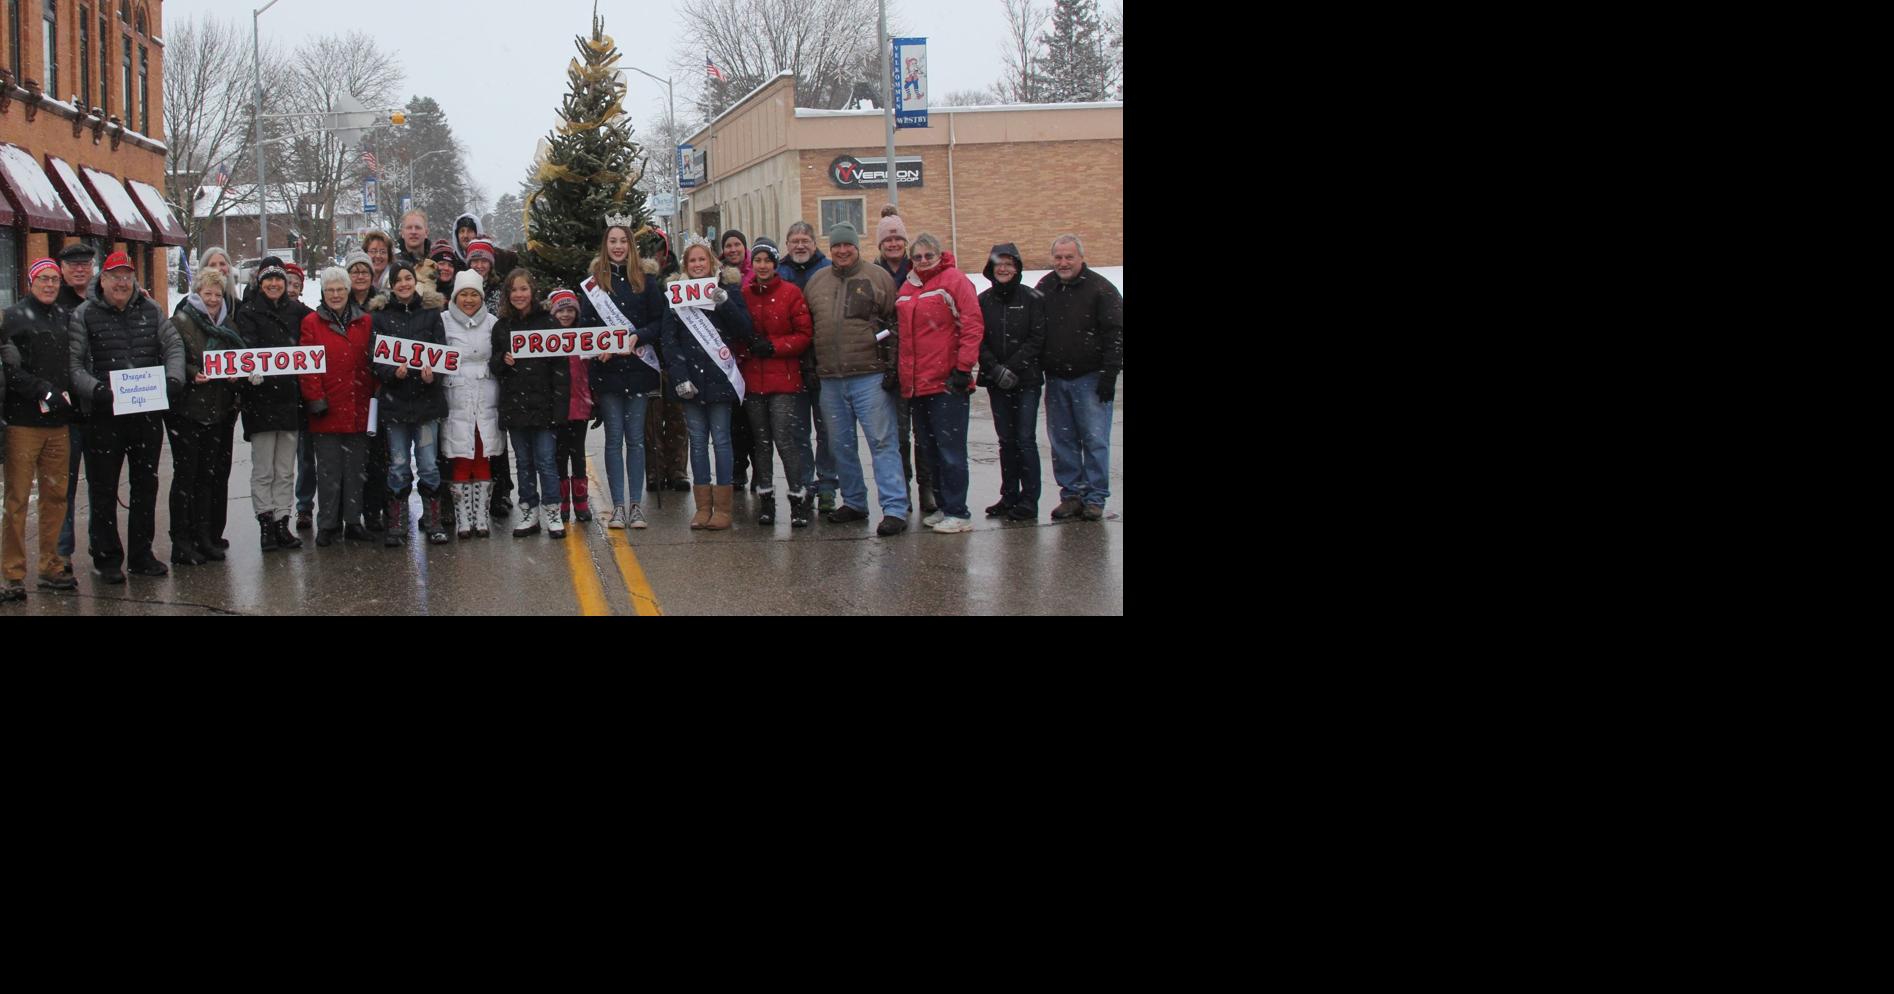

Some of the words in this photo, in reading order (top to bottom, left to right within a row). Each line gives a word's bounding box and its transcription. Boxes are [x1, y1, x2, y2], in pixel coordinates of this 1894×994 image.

[896, 116, 927, 124] WESTBY
[852, 169, 919, 179] VERON
[512, 329, 628, 353] PROJECT
[205, 349, 325, 376] HISTORY
[374, 339, 460, 371] ALIVE
